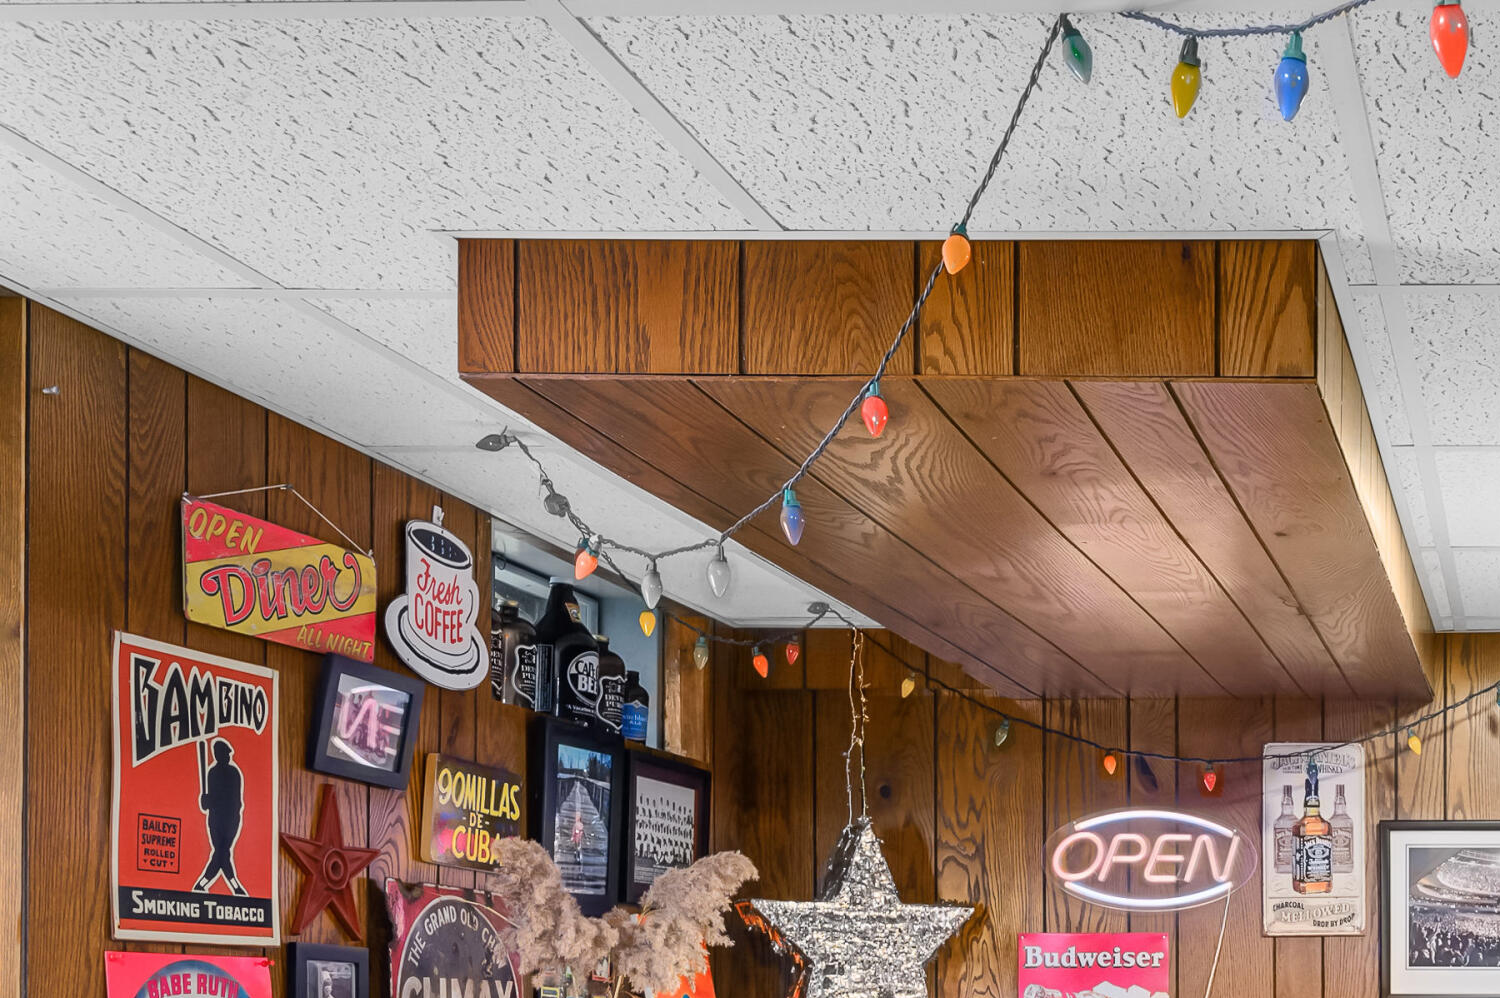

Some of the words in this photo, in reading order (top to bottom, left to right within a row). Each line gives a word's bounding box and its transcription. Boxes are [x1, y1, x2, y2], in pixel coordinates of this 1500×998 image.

[189, 508, 264, 554] OPEN
[200, 552, 362, 627] Diner
[417, 558, 463, 605] Fresh
[414, 593, 463, 644] COFFEE
[297, 625, 321, 647] ALL
[326, 634, 371, 659] NIGHT
[132, 655, 267, 766] BAMBINO
[141, 834, 176, 847] SUPREME
[144, 848, 175, 859] ROLLED
[1052, 831, 1241, 883] OPEN
[150, 859, 168, 868] CUT
[132, 890, 200, 918] SMOKING
[204, 901, 265, 923] TOBACCO
[1273, 902, 1304, 912] CHARCOAL
[1280, 903, 1351, 923] MELLOWED
[1313, 920, 1328, 928] DROP
[1340, 913, 1355, 926] DROP
[408, 931, 427, 967] THE
[424, 905, 457, 936] GRAND
[460, 908, 479, 931] OLD
[1023, 946, 1165, 969] Budweiser
